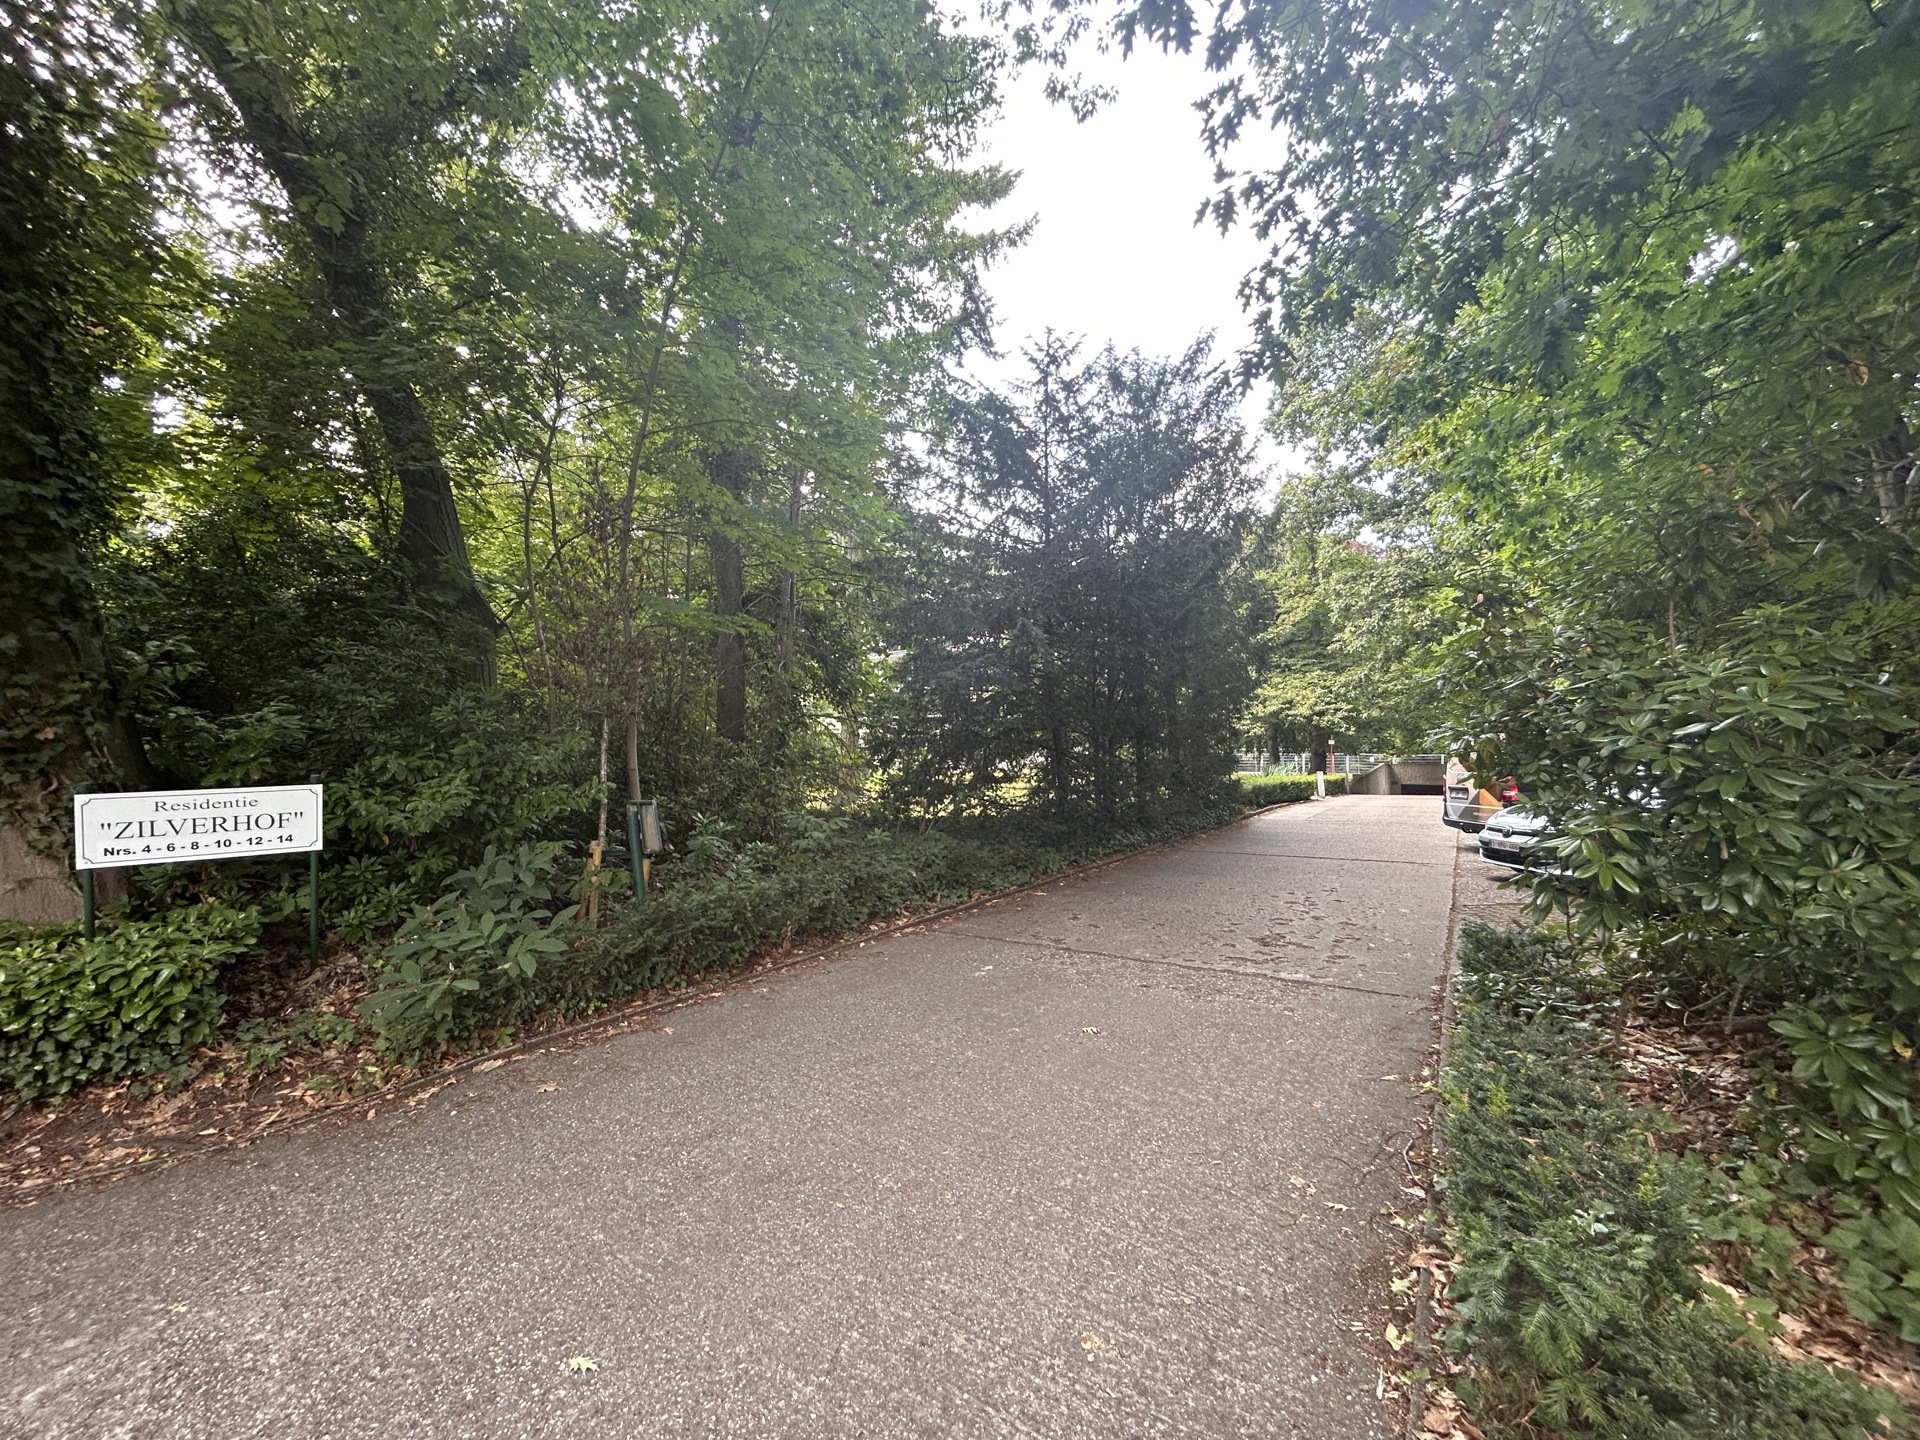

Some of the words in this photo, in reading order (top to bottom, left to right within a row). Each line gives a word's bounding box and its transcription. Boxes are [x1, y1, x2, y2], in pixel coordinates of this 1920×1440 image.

[153, 796, 259, 812] Residentie
[100, 811, 304, 840] "ZILVERHOF"
[103, 847, 137, 857] Nrs.
[141, 844, 151, 854] 4
[166, 842, 176, 852] 6
[190, 841, 200, 851] 8
[214, 839, 232, 849] 10
[246, 836, 264, 846] 12
[276, 834, 294, 844] 14
